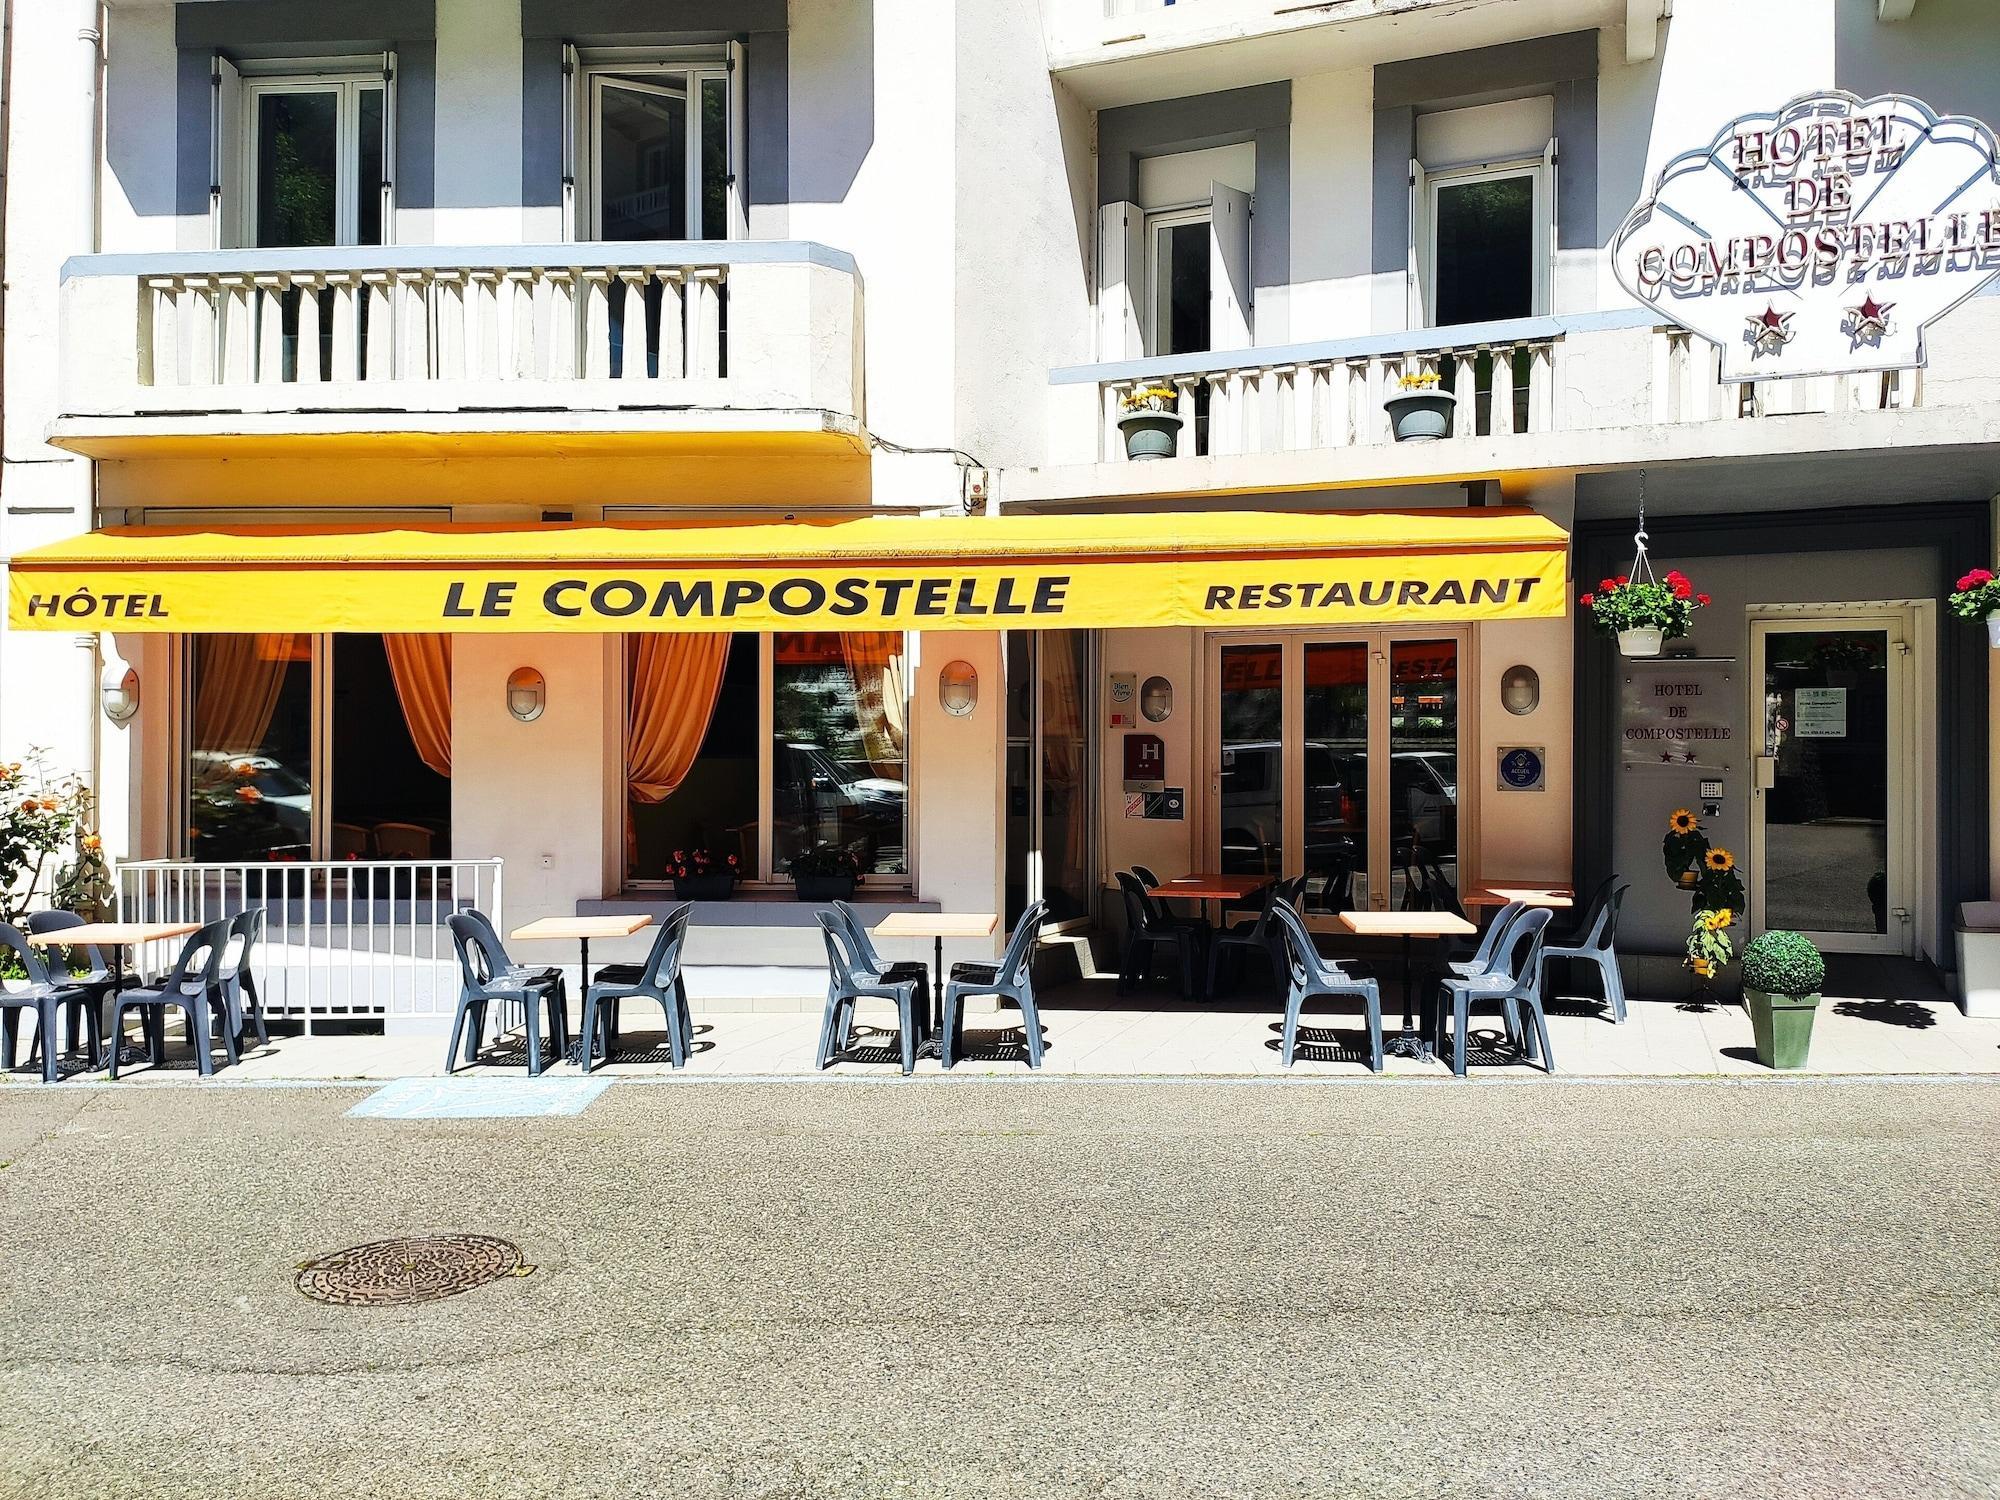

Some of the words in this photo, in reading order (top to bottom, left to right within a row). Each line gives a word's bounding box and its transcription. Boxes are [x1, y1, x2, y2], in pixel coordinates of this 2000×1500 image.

[1734, 114, 1907, 173] HOTEL
[1786, 171, 1853, 219] DE
[28, 586, 169, 617] HÔTEL
[443, 581, 518, 617] LE
[542, 576, 1071, 618] COMPOSTELLE
[1204, 578, 1542, 611] RESTAURANT
[1655, 684, 1703, 696] HOTEL
[1668, 706, 1688, 718] DE
[1625, 728, 1731, 740] COMPOSTELLE
[1142, 743, 1159, 760] H
